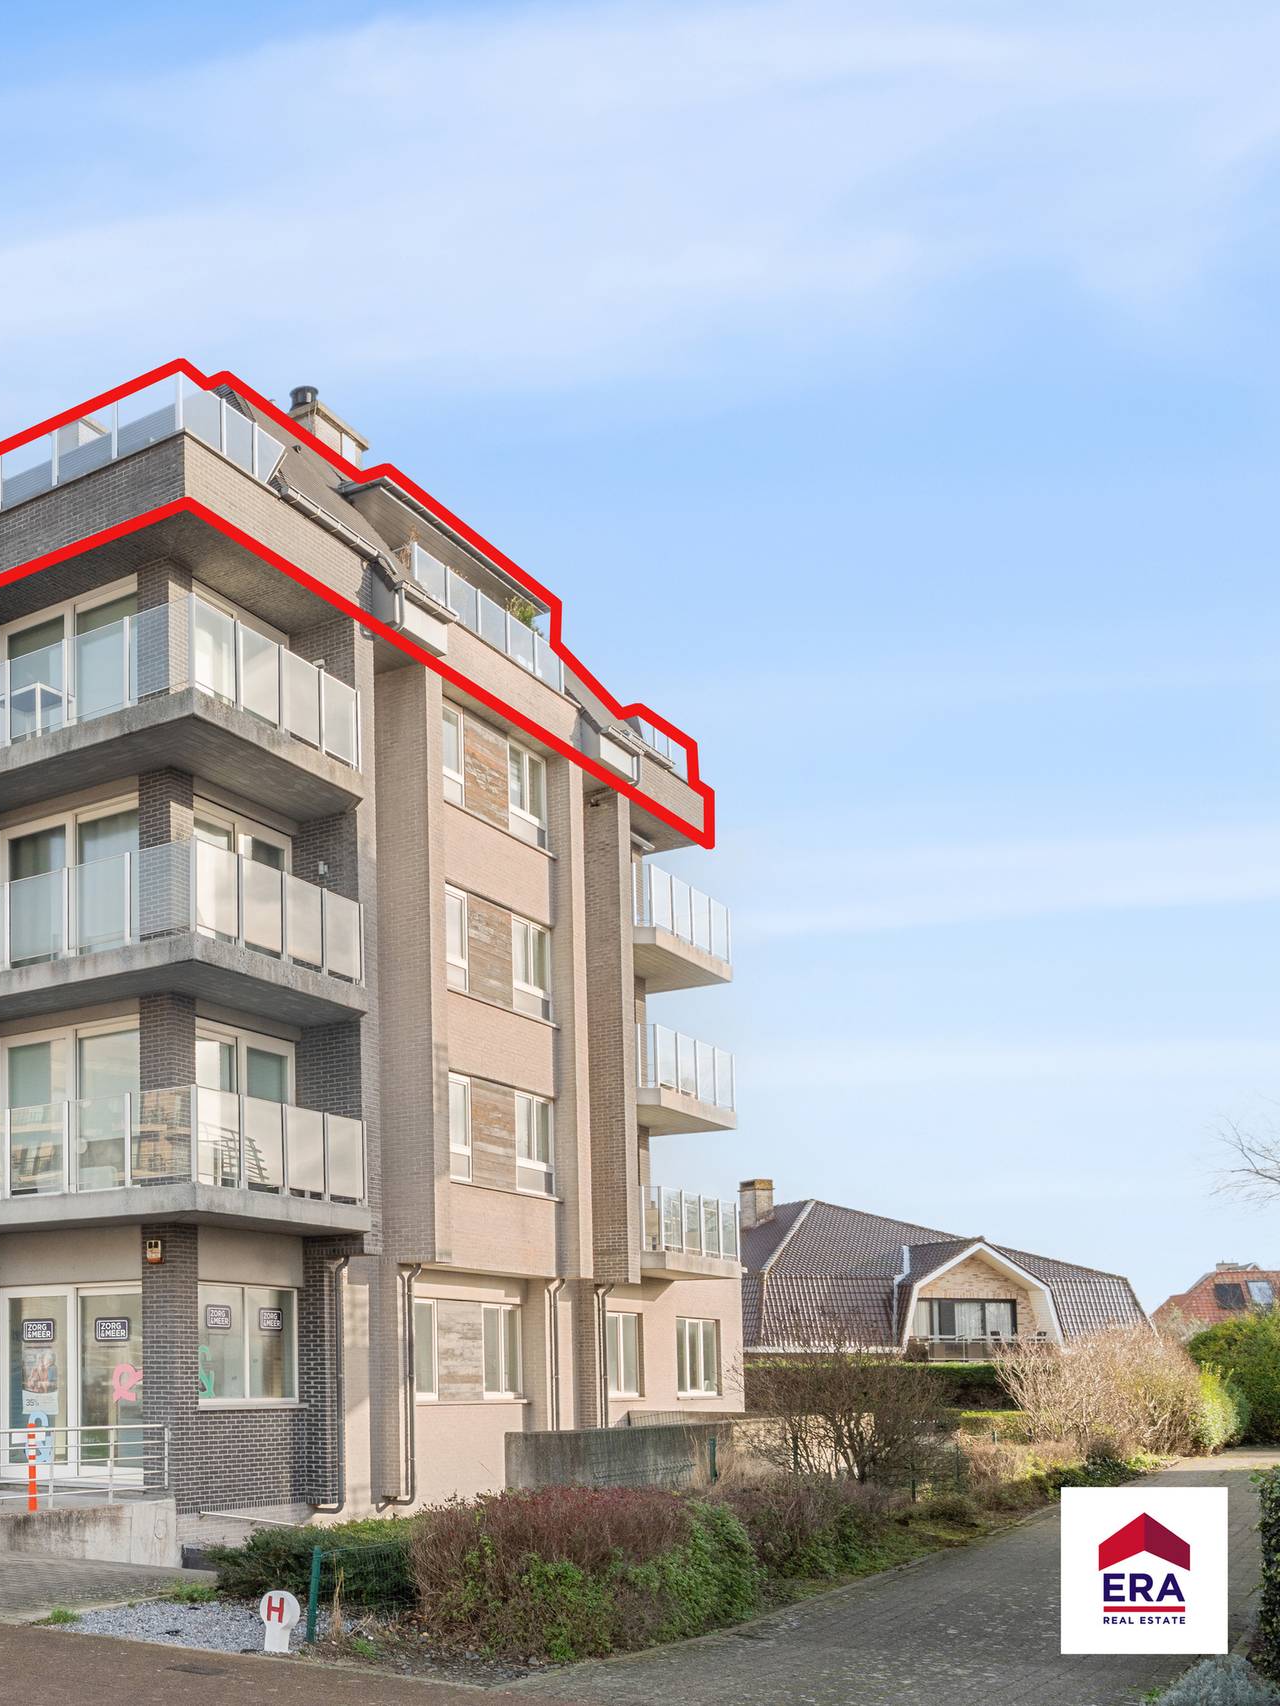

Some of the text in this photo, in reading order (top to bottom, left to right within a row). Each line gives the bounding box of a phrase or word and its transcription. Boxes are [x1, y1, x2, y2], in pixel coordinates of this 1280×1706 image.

[210, 1309, 226, 1317] ZORG
[263, 1312, 278, 1320] ZORG
[27, 1323, 47, 1331] ZORG
[100, 1322, 122, 1330] ZORG
[100, 1329, 126, 1337] &MEER
[266, 1595, 285, 1623] H
